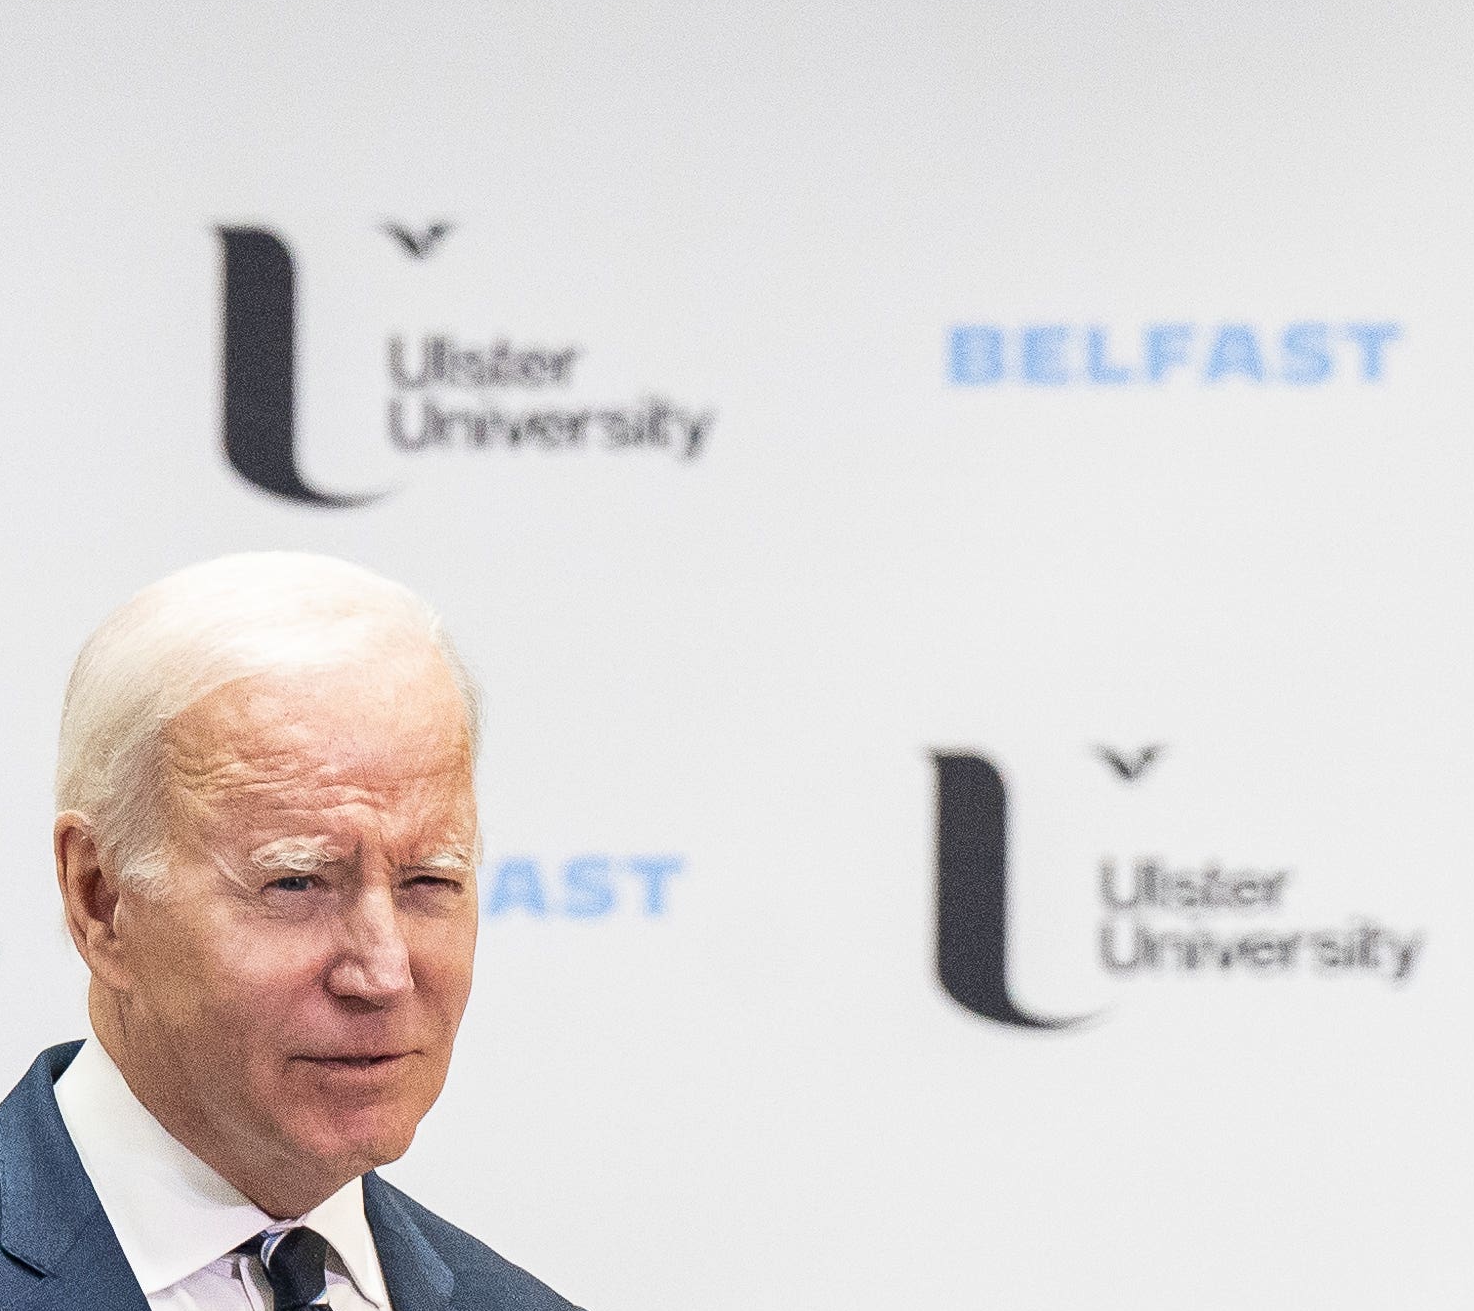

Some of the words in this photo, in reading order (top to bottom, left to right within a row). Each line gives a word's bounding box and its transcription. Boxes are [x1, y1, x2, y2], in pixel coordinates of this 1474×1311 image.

[388, 333, 579, 389] Ulster
[944, 321, 1400, 388] BELFAST
[388, 398, 711, 458] University
[1100, 859, 1288, 911] Ulster
[1099, 923, 1420, 981] University
